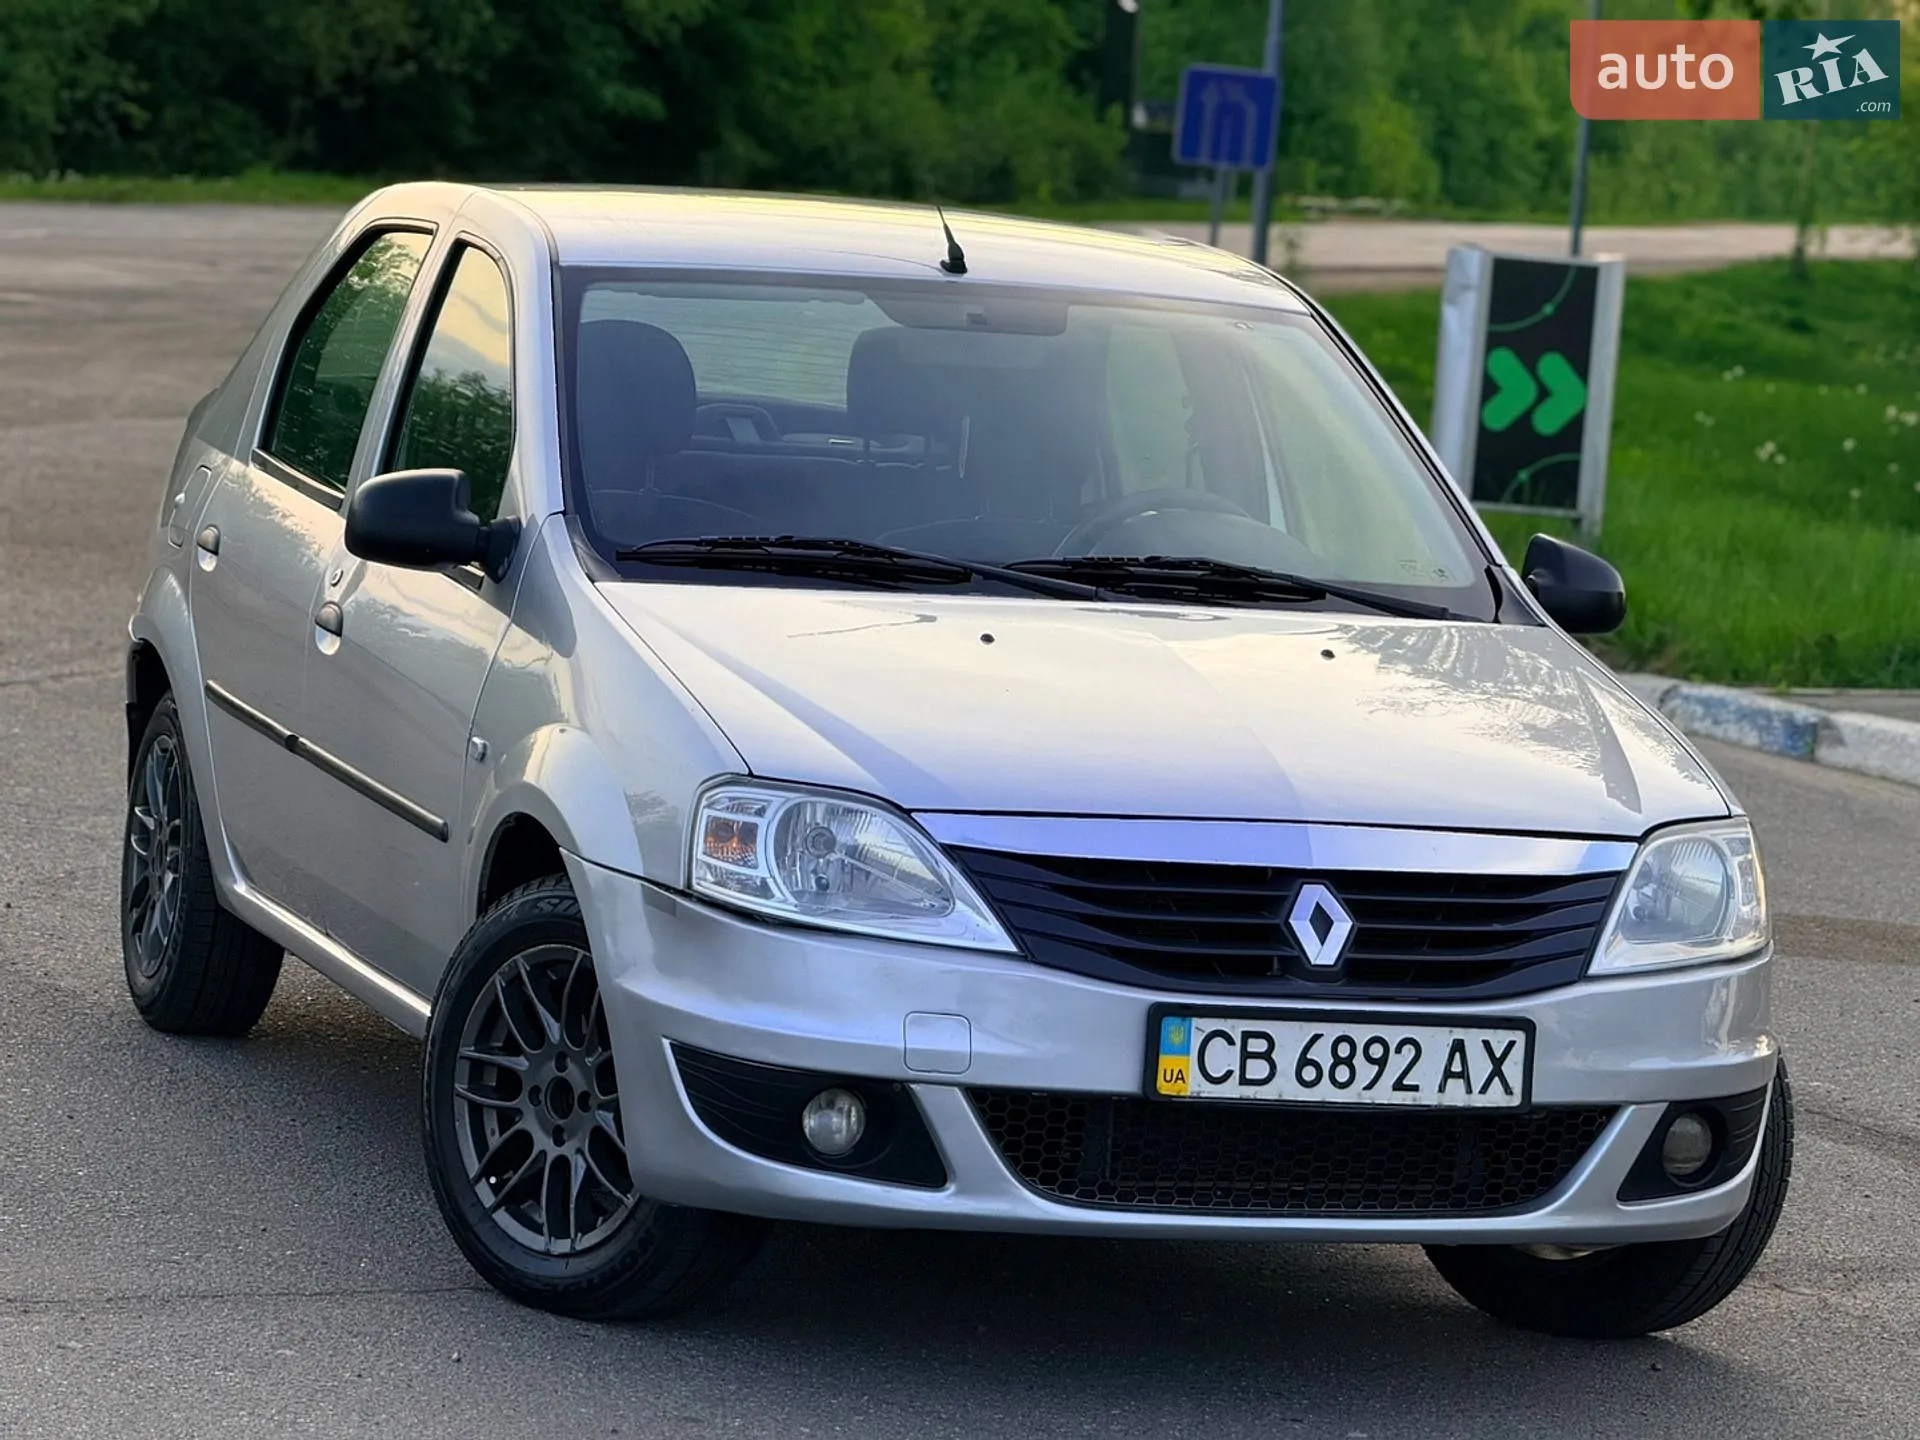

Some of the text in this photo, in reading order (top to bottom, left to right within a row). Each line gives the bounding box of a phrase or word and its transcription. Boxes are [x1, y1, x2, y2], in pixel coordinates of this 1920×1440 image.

[1162, 1067, 1187, 1086] UA
[1197, 1029, 1517, 1096] CB 6892 AX
